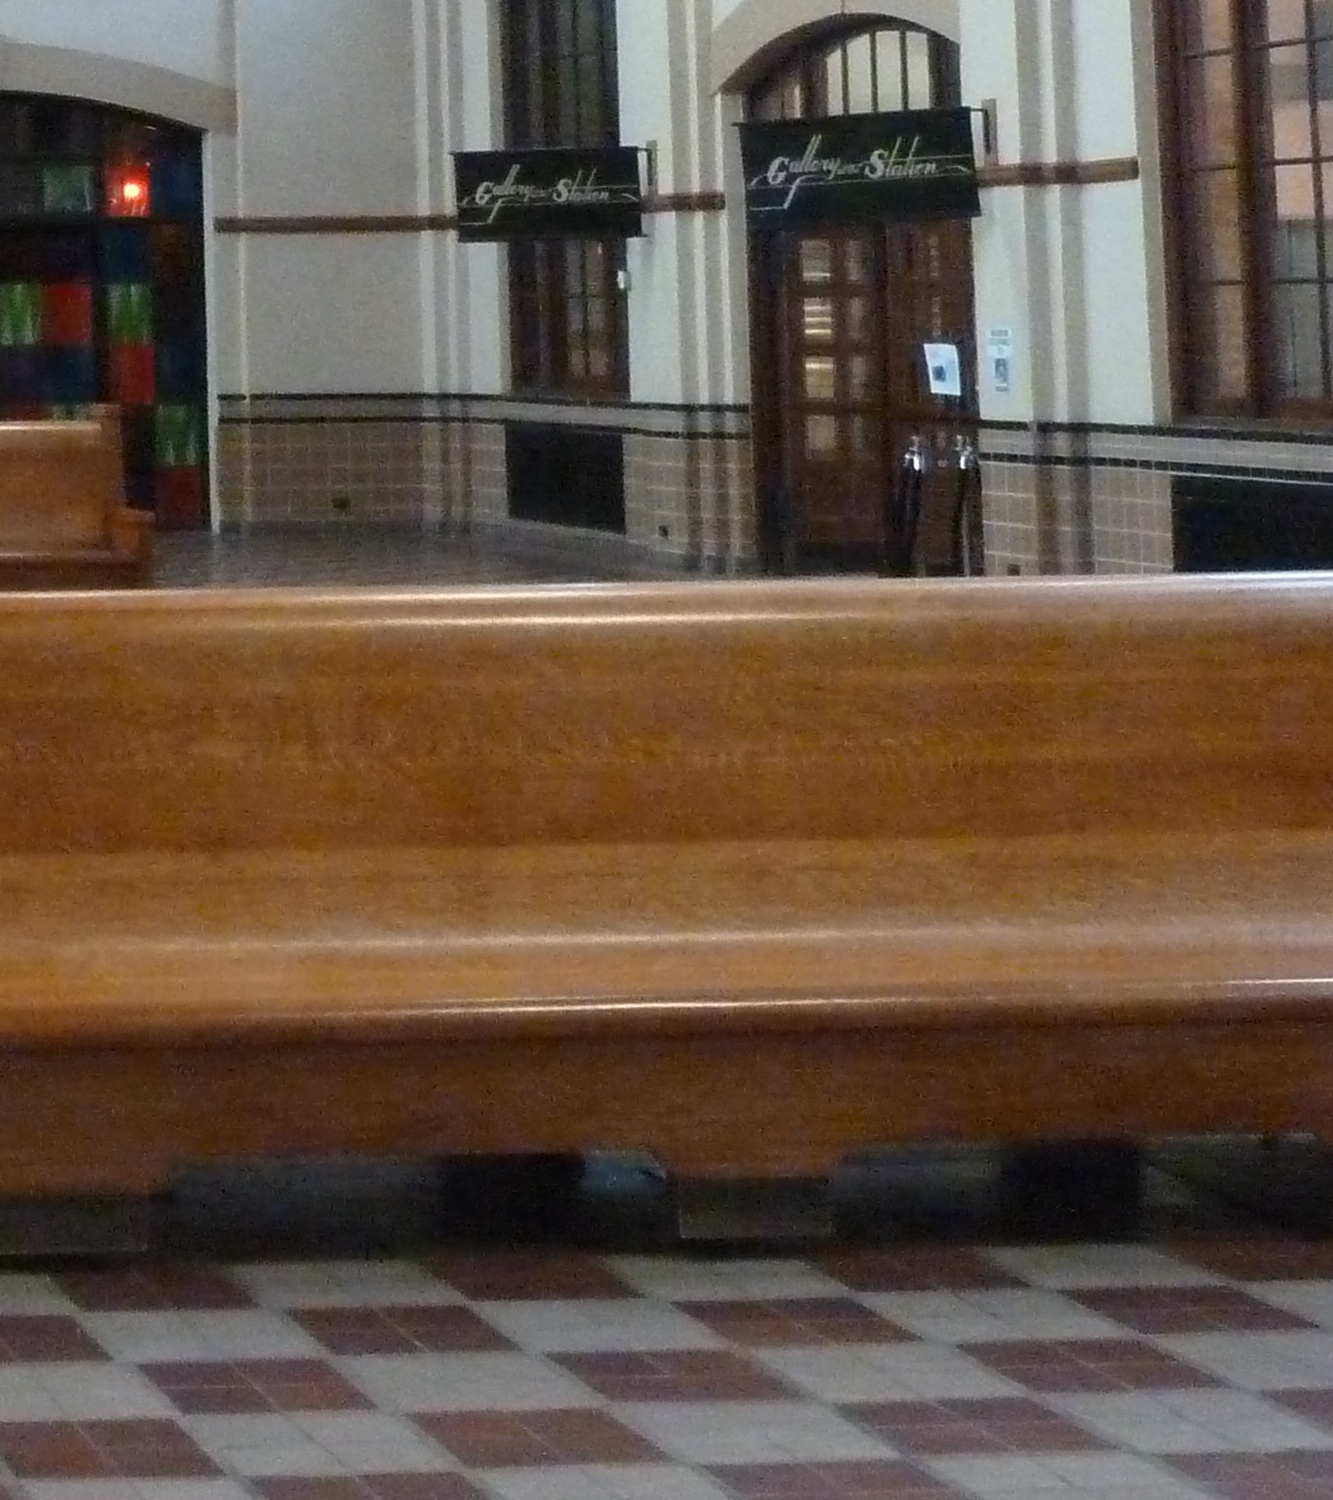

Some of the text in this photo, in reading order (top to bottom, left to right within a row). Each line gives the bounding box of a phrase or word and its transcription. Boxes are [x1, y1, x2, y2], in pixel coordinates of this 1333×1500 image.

[766, 134, 937, 185] Gallery Station
[475, 164, 610, 204] Gallery Station
